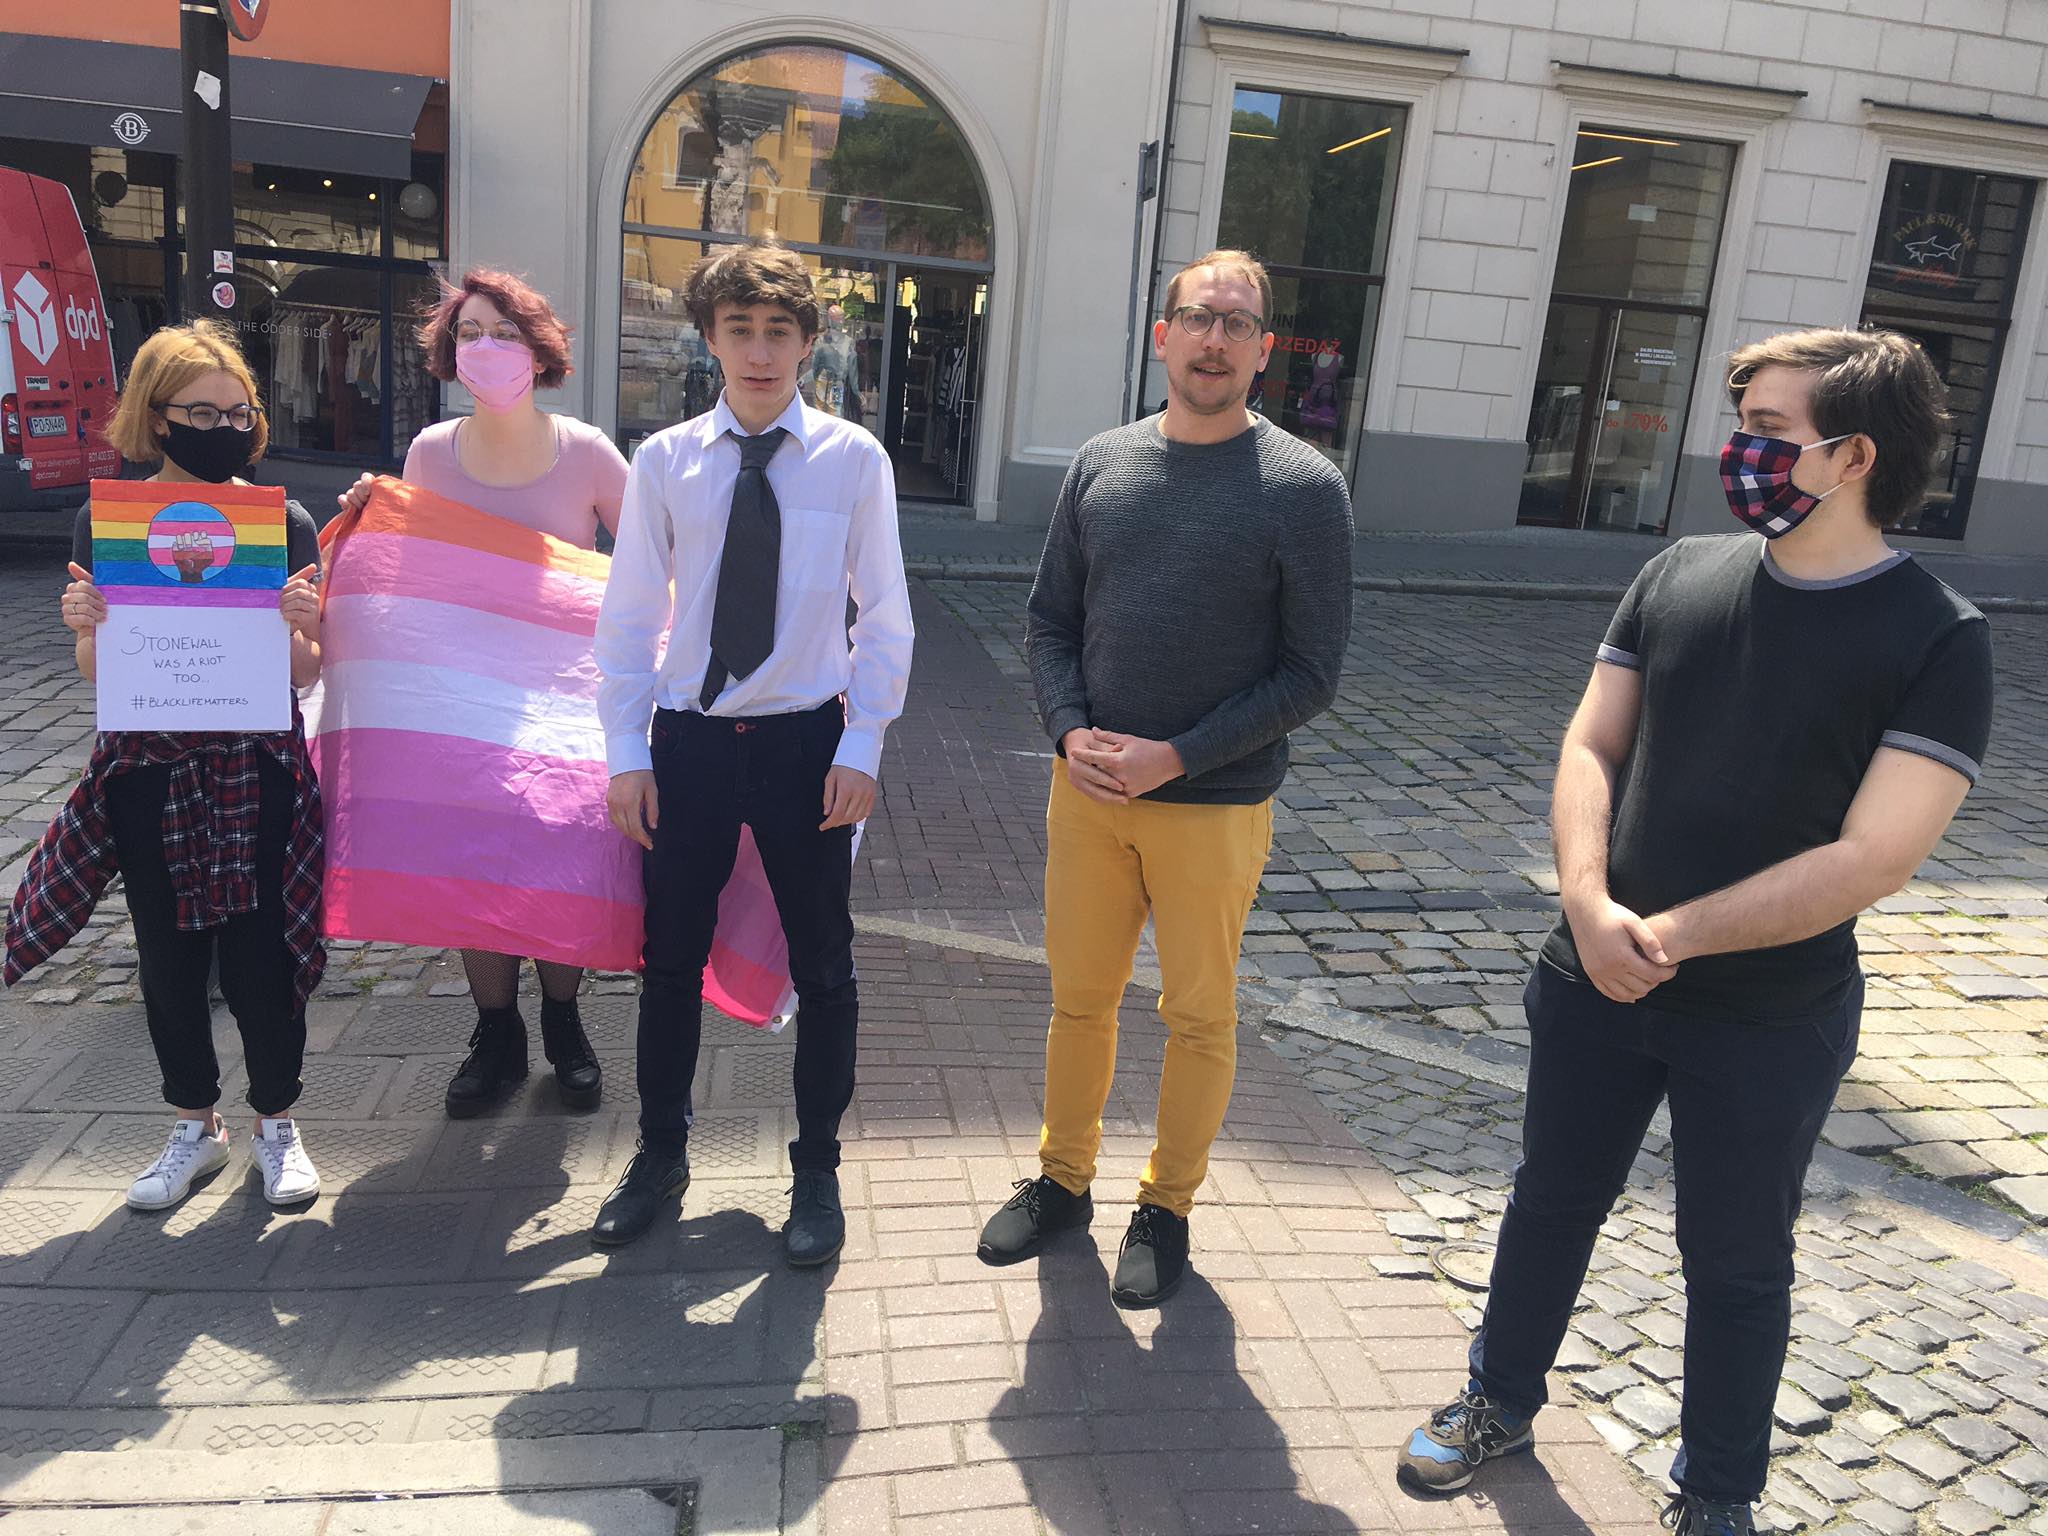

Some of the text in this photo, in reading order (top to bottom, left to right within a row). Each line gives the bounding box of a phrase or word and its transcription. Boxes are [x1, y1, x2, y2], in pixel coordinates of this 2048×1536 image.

[66, 294, 101, 351] dpd
[238, 320, 257, 332] THE
[260, 322, 300, 336] ODDER
[121, 626, 223, 655] STONEWALL
[154, 656, 226, 669] WAS A RIOT
[131, 695, 249, 710] #BLACKLIFEMATTERS
